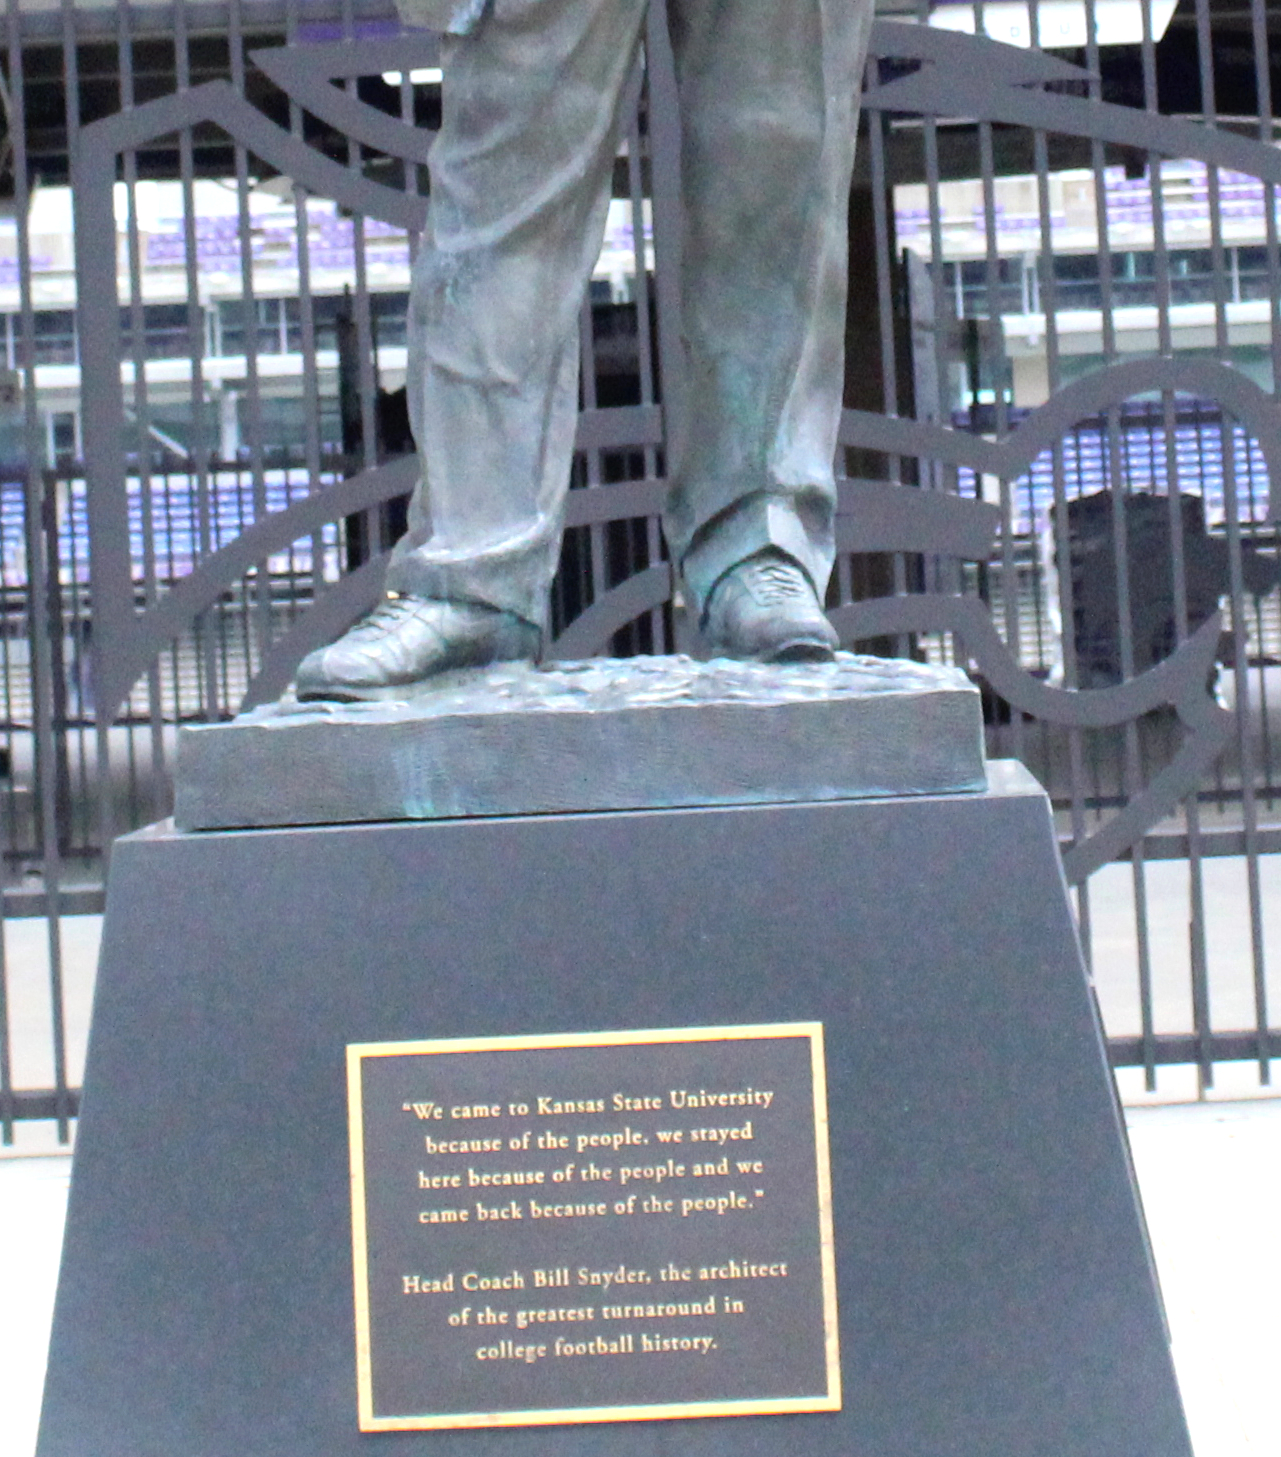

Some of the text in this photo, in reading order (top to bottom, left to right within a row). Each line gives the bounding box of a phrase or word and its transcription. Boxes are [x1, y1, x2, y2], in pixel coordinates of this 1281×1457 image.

[451, 1104, 501, 1119] came
[509, 1103, 529, 1116] to
[536, 1096, 605, 1115] Kansas
[613, 1093, 662, 1111] State
[670, 1087, 774, 1109] University
[425, 1135, 502, 1154] because
[509, 1131, 531, 1150] of
[537, 1130, 569, 1149] the
[656, 1130, 683, 1143] we
[690, 1121, 753, 1145] stayed
[418, 1157, 763, 1189] here because of the people and we
[418, 1208, 469, 1224] came
[476, 1200, 523, 1221] back
[530, 1199, 607, 1219] because
[614, 1195, 637, 1214] of
[642, 1195, 674, 1213] the
[402, 1259, 788, 1294] Head Coach Bill Snyder, the architect
[448, 1296, 744, 1329] of the greatest turnaround in
[475, 1333, 718, 1363] college football history.
